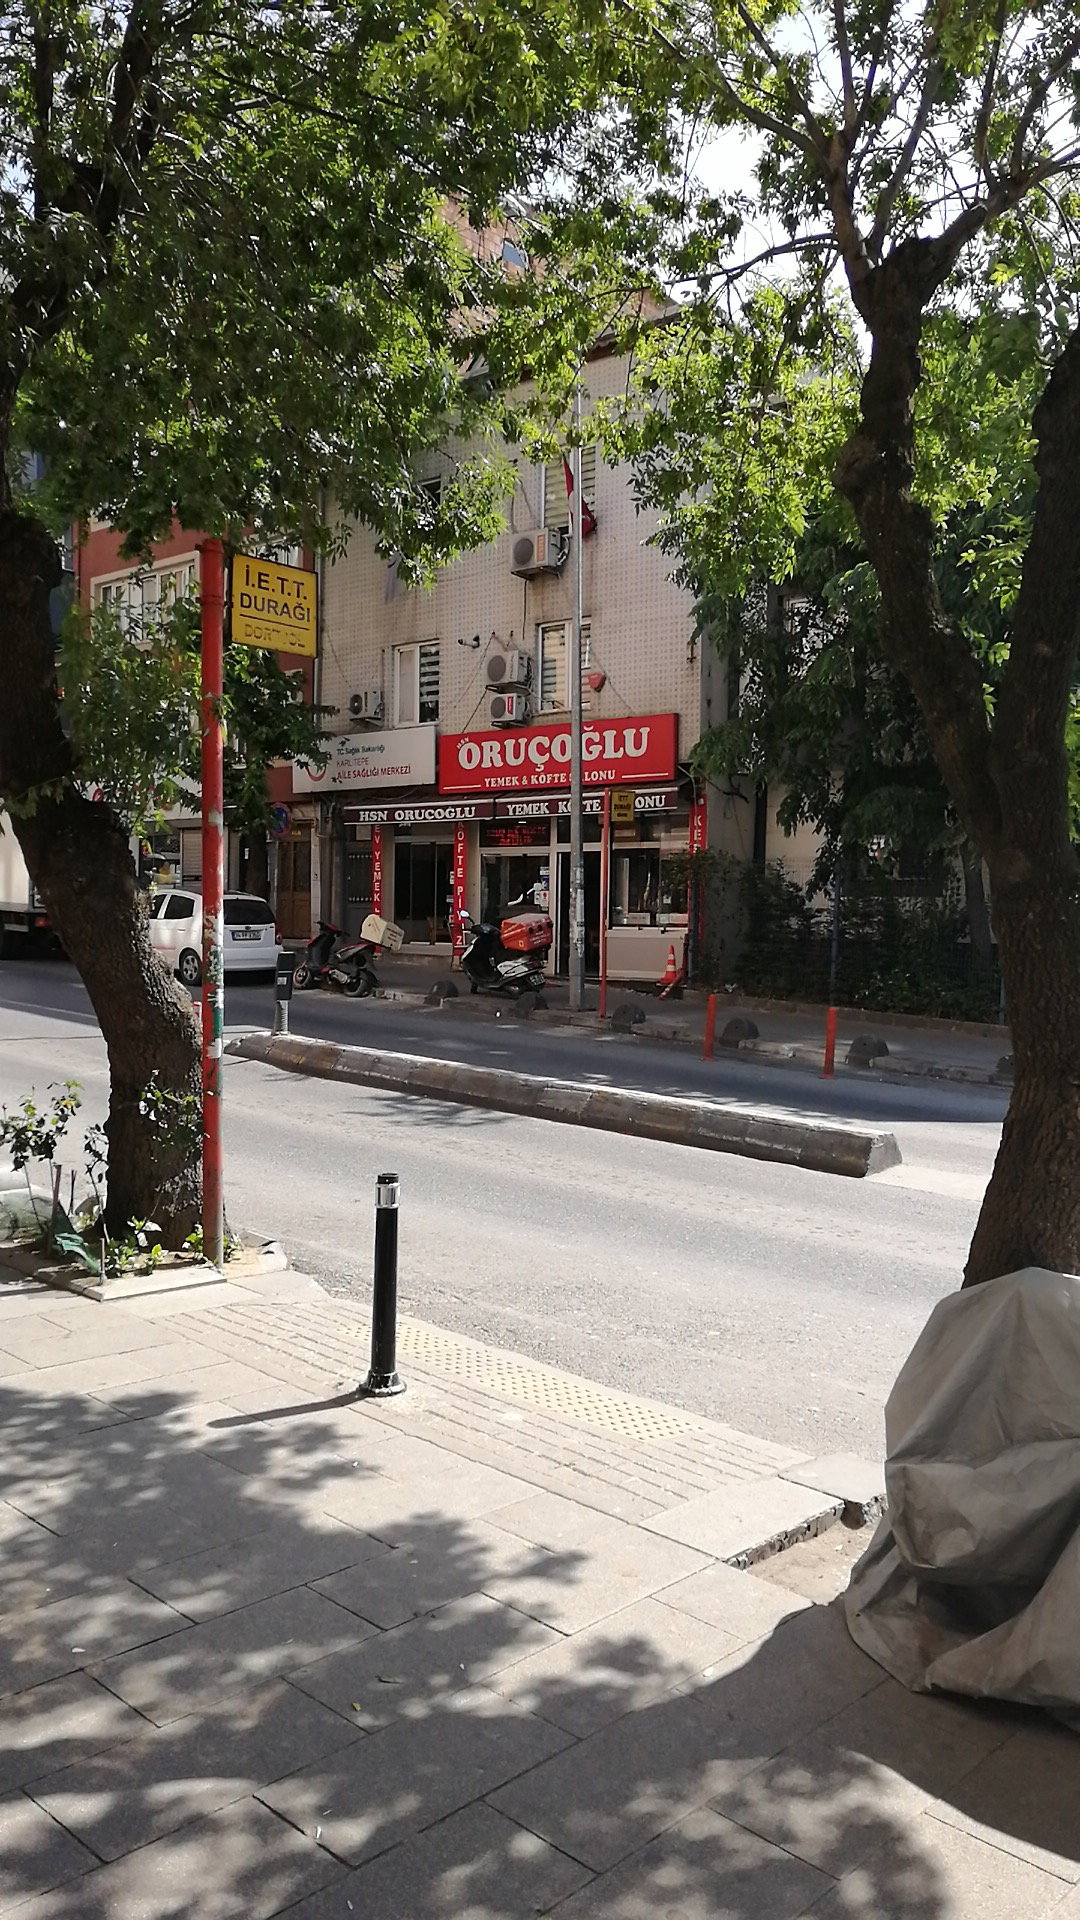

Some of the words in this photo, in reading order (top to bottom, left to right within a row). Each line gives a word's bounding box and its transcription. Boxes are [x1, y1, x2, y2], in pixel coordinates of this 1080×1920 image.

[244, 564, 308, 600] İ.E.T.T.
[239, 592, 312, 623] DURAĞI
[457, 725, 651, 772] ORUÇOĞLU
[352, 766, 380, 779] SAĞLIĞI
[380, 764, 411, 777] MERKEZİ
[484, 776, 520, 788] YEMEK
[521, 776, 528, 786] &
[359, 810, 388, 822] HSN
[507, 802, 550, 816] YEMEK
